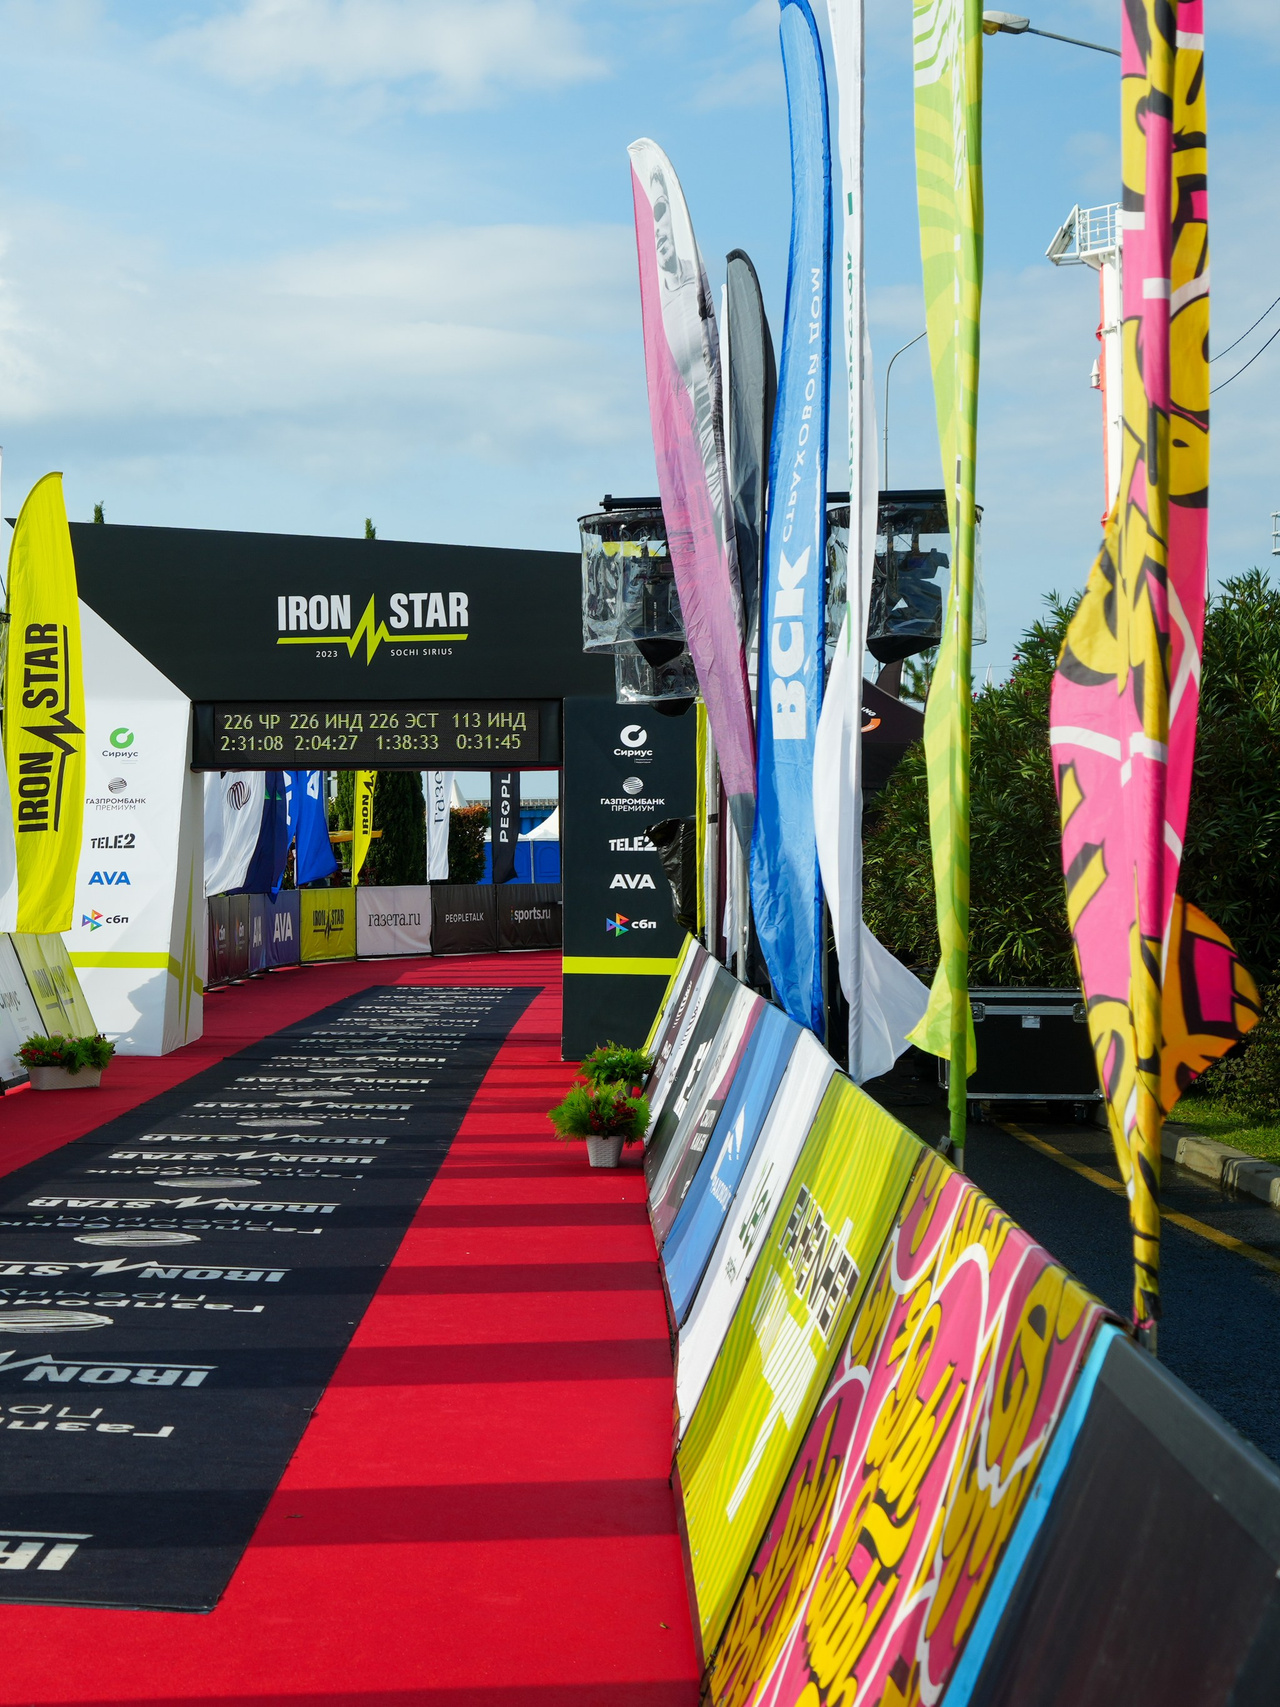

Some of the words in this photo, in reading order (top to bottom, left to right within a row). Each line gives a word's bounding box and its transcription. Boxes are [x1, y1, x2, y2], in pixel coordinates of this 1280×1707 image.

[277, 594, 351, 631] IRON
[389, 592, 469, 629] STAR
[315, 650, 338, 658] 2023
[422, 648, 453, 656] SIRIUS
[22, 623, 58, 709] STAR
[223, 714, 253, 730] 226
[259, 714, 281, 730] ЧР
[289, 714, 319, 730] 226
[325, 713, 363, 732] ИНД
[369, 713, 399, 729] 226
[405, 713, 439, 729] ЭСТ
[452, 712, 481, 728] 113
[488, 712, 527, 731] ИНД
[220, 735, 284, 751] 2:31:08
[294, 735, 358, 751] 2:04:27
[376, 734, 439, 750] 1:38:33
[456, 734, 521, 750] 0:31:45
[613, 749, 653, 757] Сириус
[18, 751, 54, 833] IRON
[90, 833, 135, 849] TELE2
[609, 835, 657, 851] TELE2
[88, 871, 131, 885] AVA
[609, 874, 656, 889] AVA
[106, 915, 129, 924] сбп
[368, 913, 421, 926] газета.ru
[445, 912, 484, 923] PEOPLETALK
[514, 908, 551, 923] sports.ru
[273, 912, 293, 943] AVA
[631, 919, 657, 929] сбп
[107, 1152, 218, 1160] STAR
[268, 1155, 373, 1163] IRON
[27, 1198, 156, 1208] STAR
[214, 1202, 336, 1213] IRON
[138, 1267, 292, 1282] IRON
[23, 1366, 215, 1387] IRON
